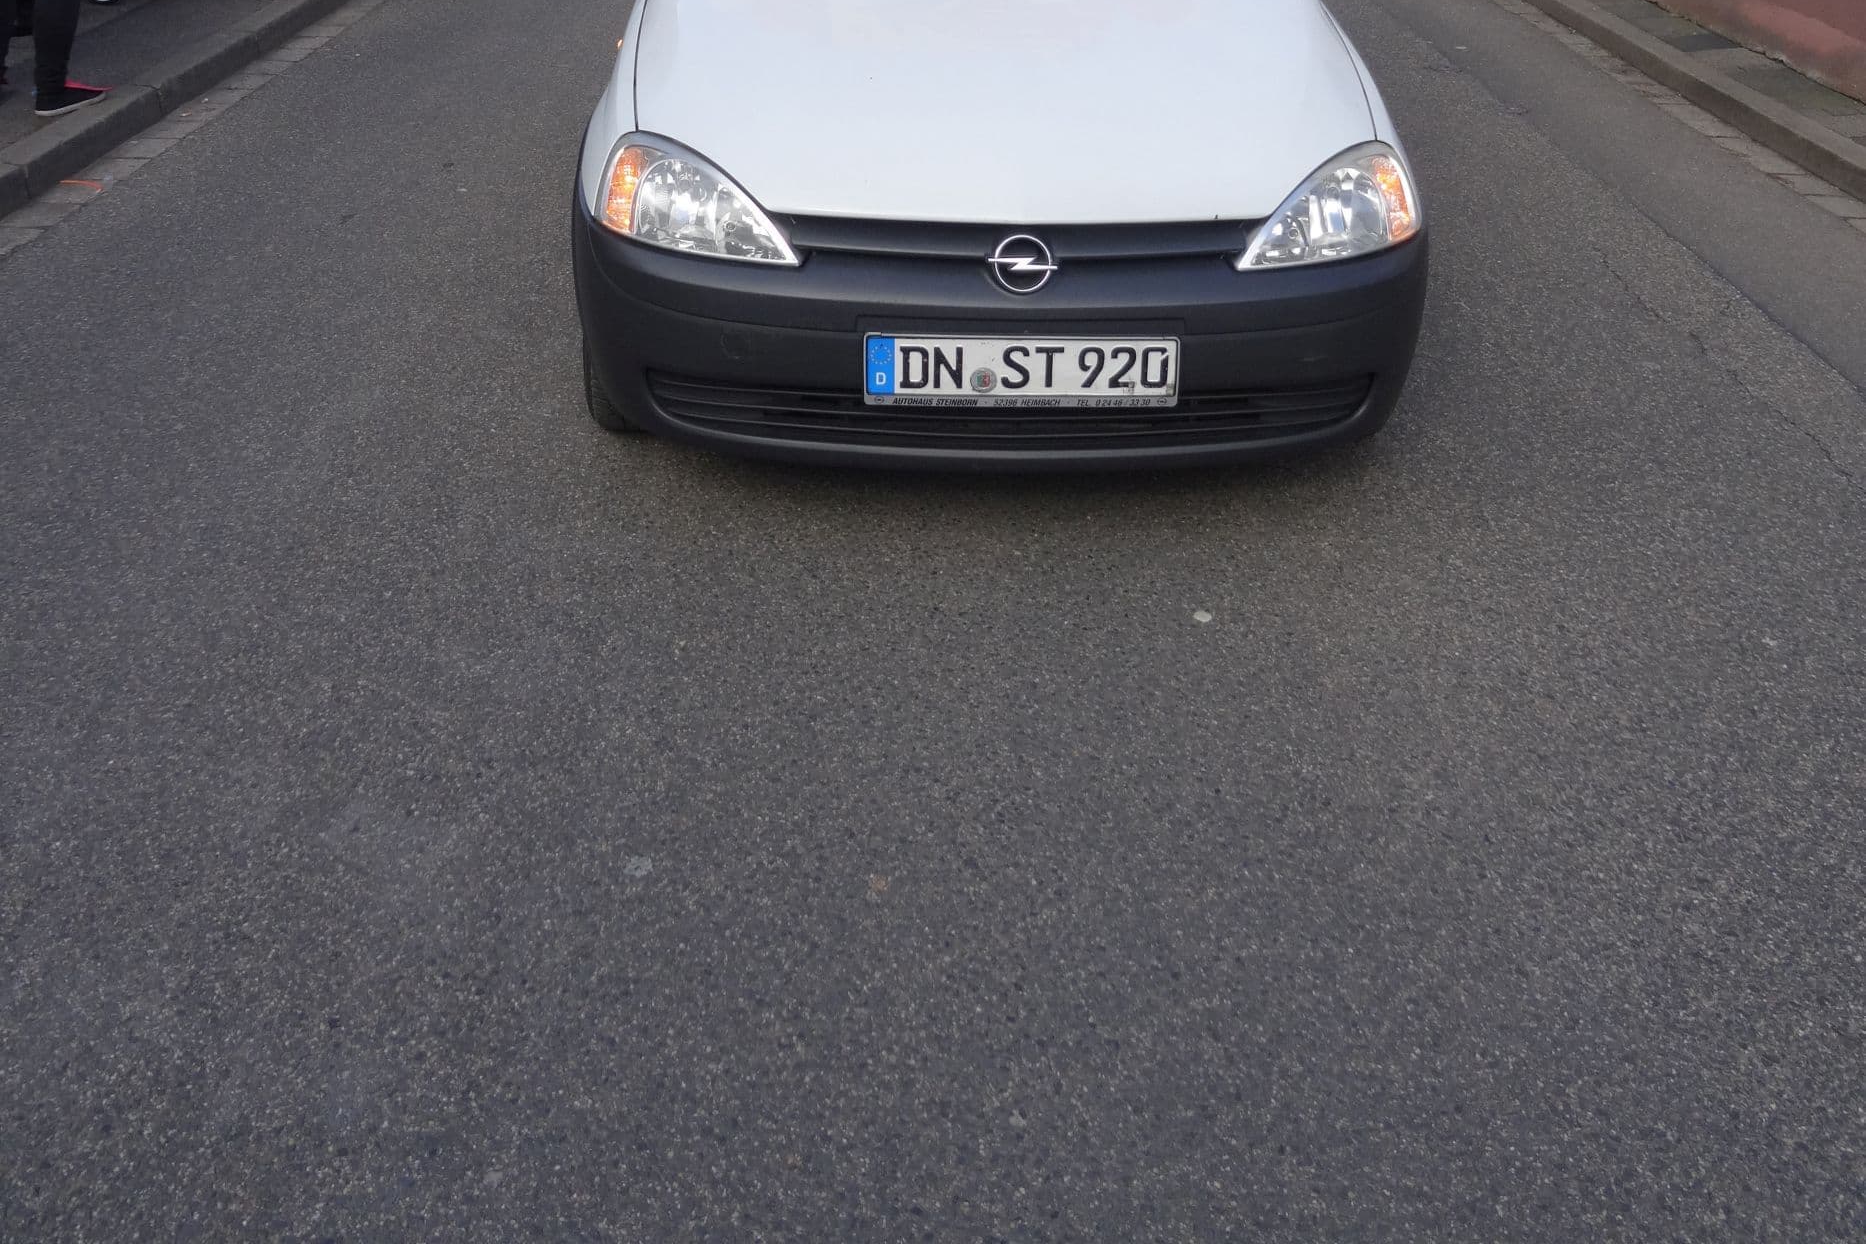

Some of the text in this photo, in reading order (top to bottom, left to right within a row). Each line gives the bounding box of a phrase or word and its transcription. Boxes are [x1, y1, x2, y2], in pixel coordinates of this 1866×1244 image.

[876, 345, 1170, 389] D DN ST 920
[893, 397, 933, 406] AUTOHAUS
[936, 397, 979, 406] STEINBORN
